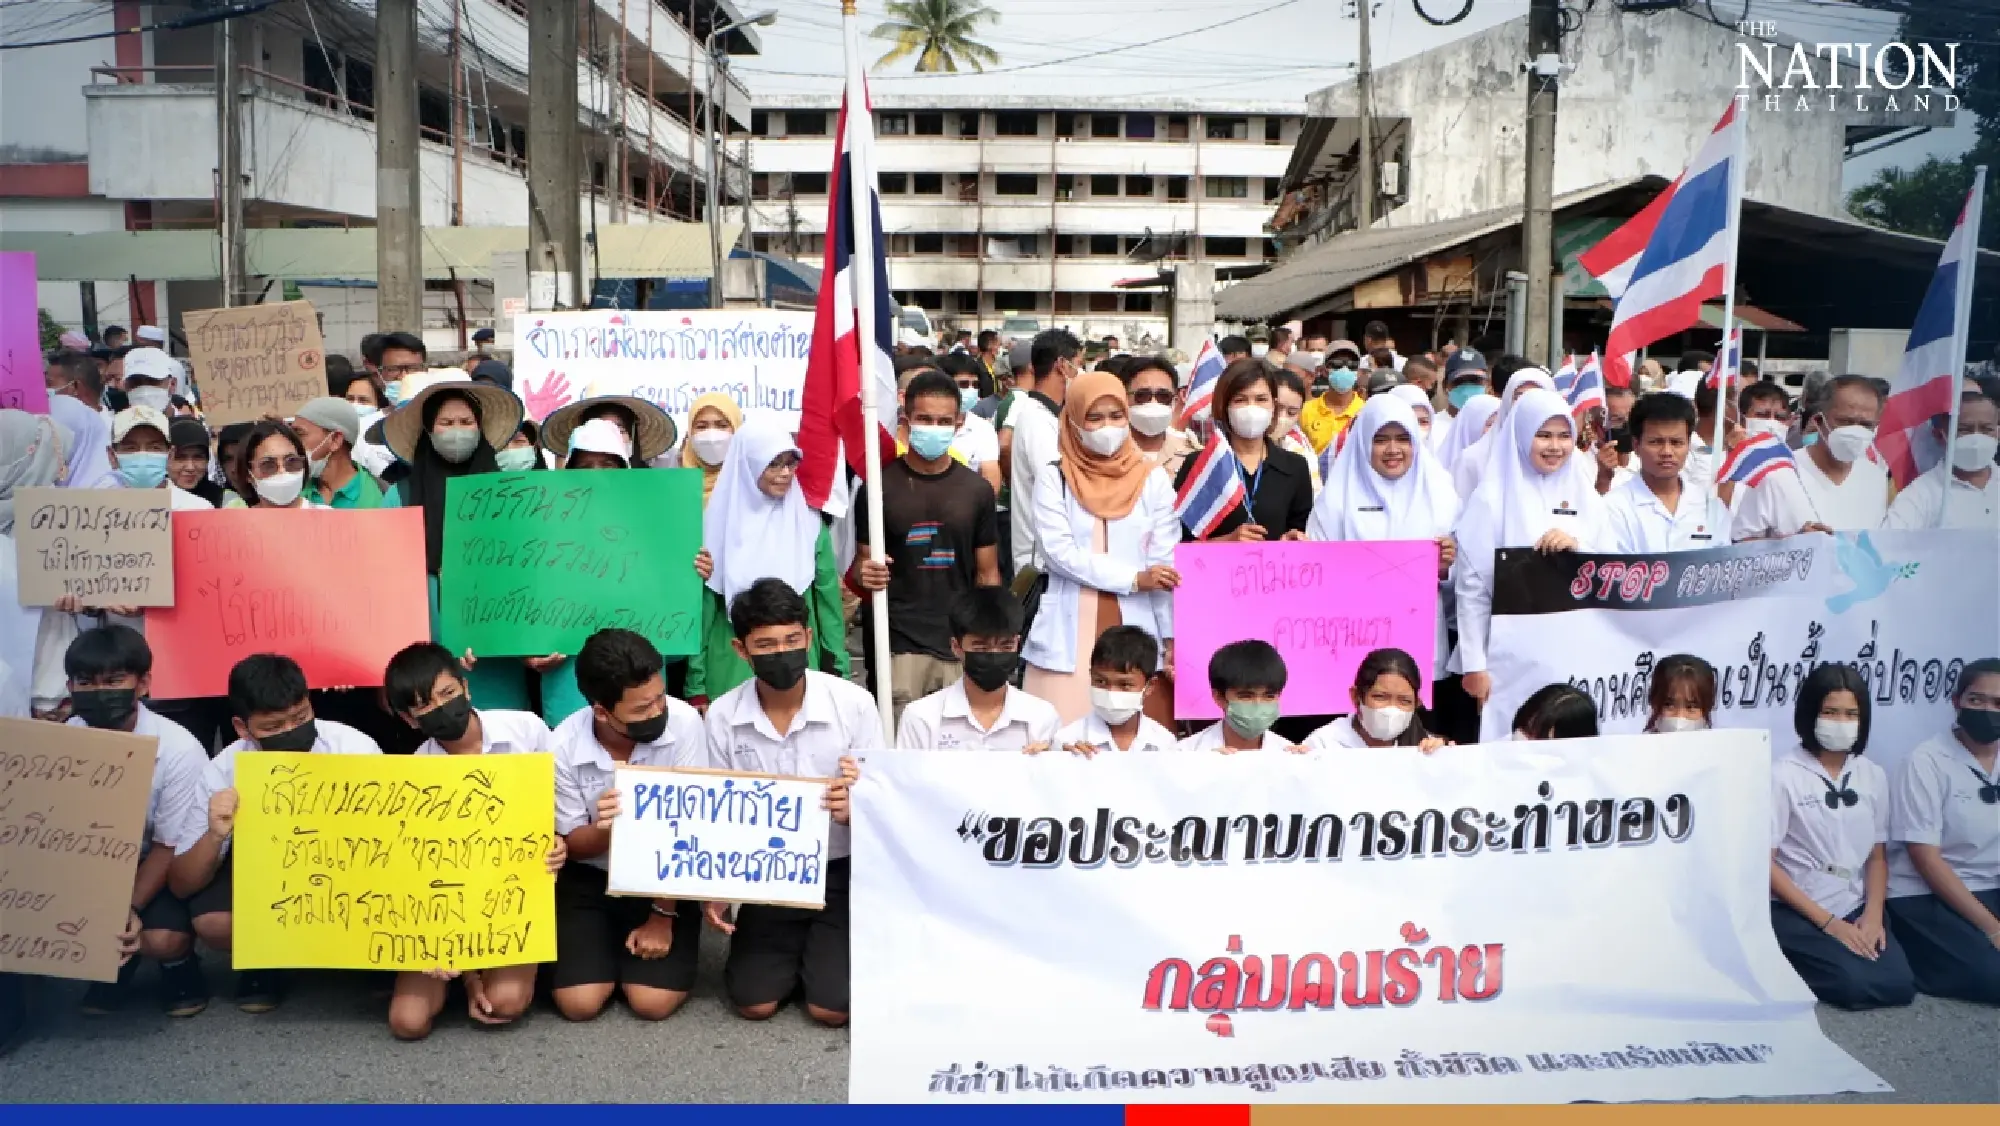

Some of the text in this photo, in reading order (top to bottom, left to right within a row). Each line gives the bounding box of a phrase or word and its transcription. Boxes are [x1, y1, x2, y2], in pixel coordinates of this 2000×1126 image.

[30, 504, 170, 544] ความรุนแรง
[1570, 559, 1670, 601] STOP
[633, 779, 802, 838] หยุดทำร้าย
[955, 780, 1695, 869] “ขอประณามการกระทำของ
[655, 834, 821, 885] เมืองนราธิวาส
[368, 920, 532, 969] ความรุนแรง
[1141, 920, 1506, 1038] กลุ่มคนร้าย
